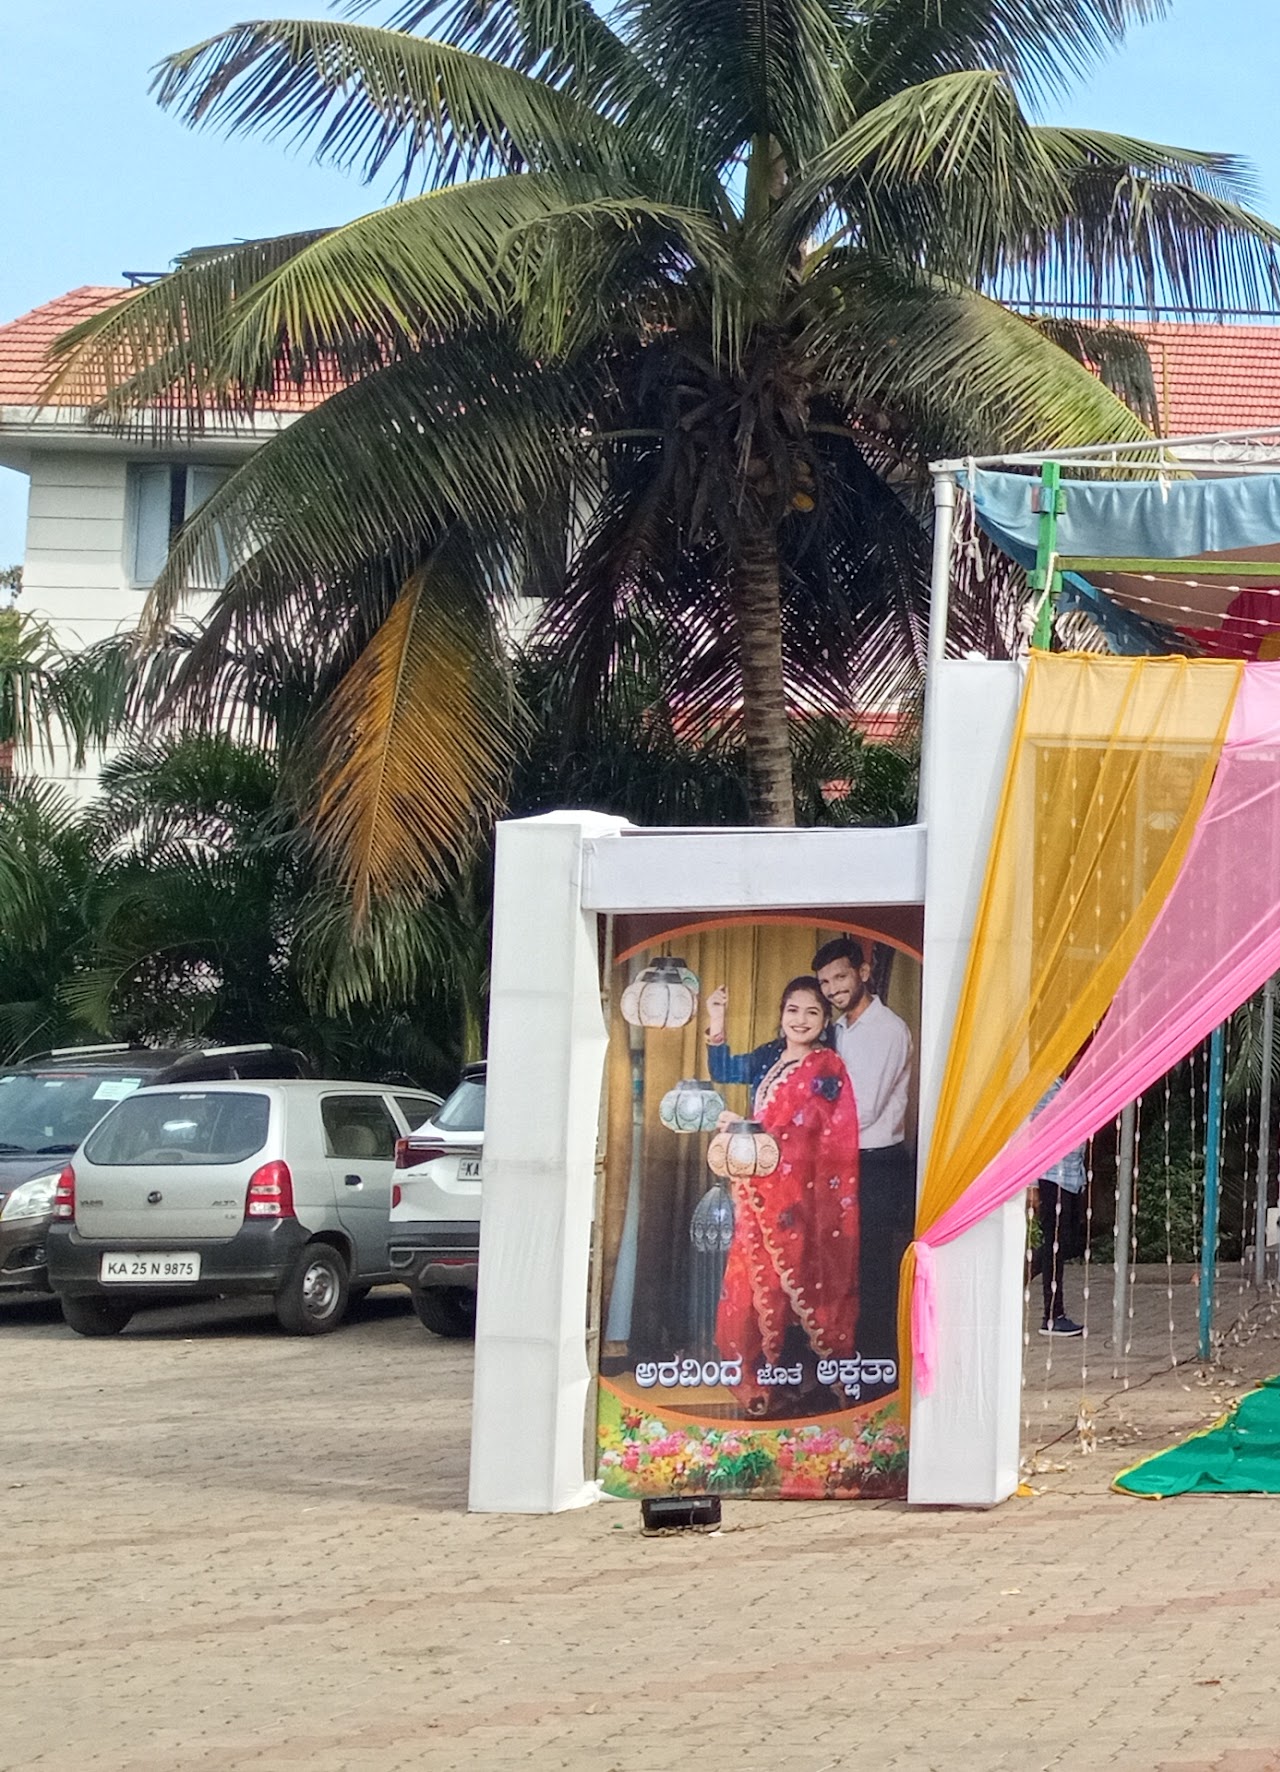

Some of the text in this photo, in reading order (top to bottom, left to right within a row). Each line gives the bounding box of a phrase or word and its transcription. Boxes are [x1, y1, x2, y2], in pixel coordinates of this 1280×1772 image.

[107, 1262, 194, 1275] KA 25 N 9875
[635, 1352, 744, 1388] ಅರವಿಂದ
[816, 1351, 898, 1400] ಅಕ್ಷತಾ
